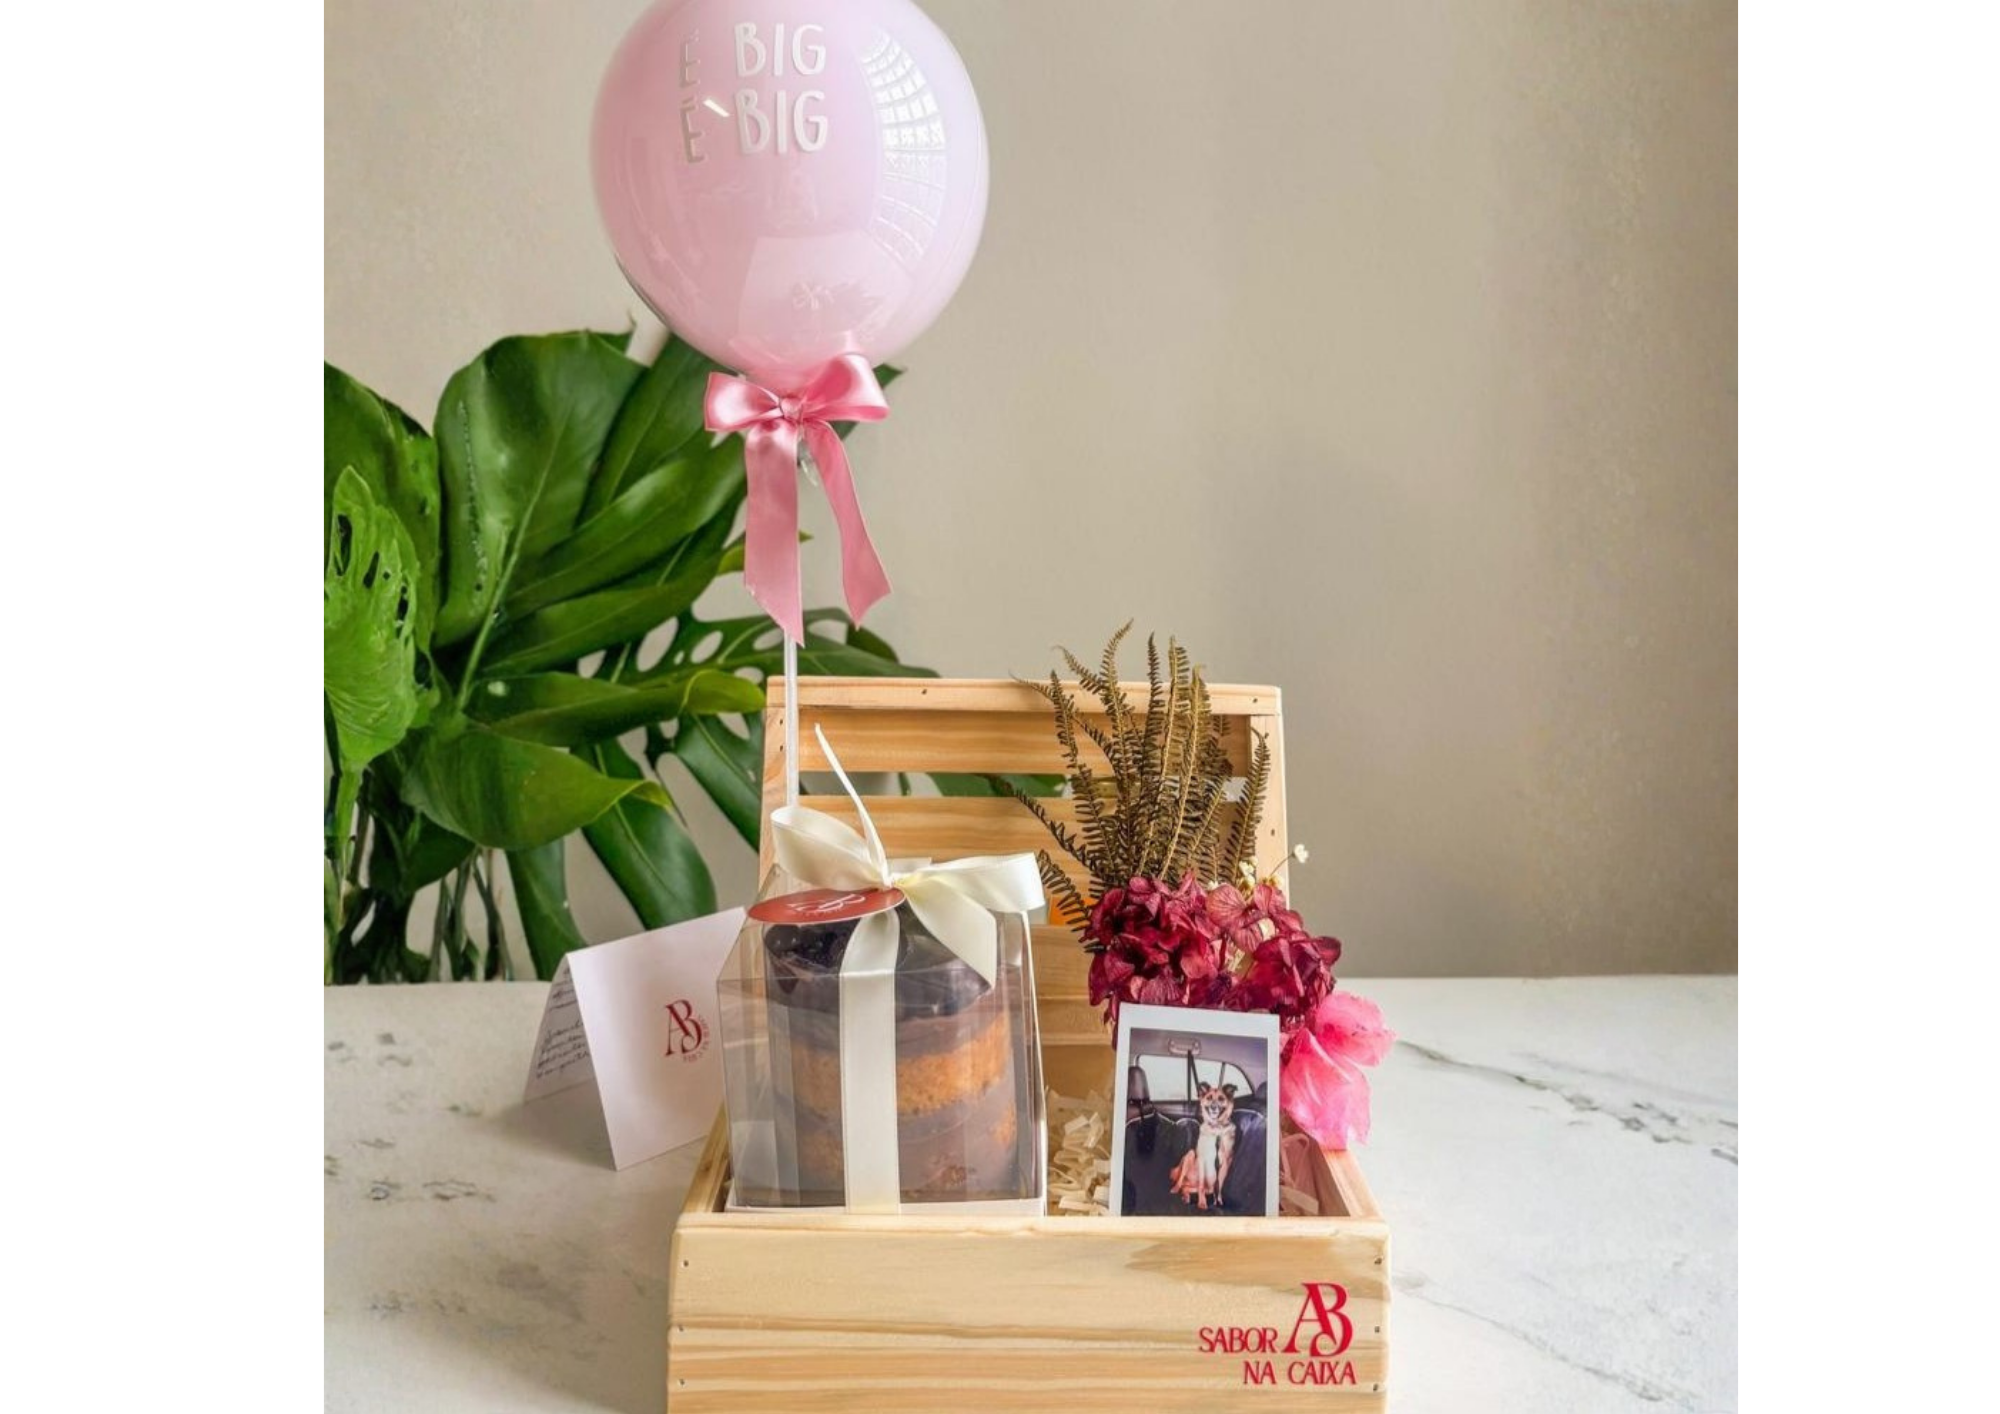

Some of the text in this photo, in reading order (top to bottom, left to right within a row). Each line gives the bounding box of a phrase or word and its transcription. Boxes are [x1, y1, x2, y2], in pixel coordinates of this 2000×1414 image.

[733, 22, 827, 78] BIG
[734, 88, 829, 155] BIG
[1199, 1327, 1278, 1353] SABOR
[1281, 1283, 1353, 1357] AB
[1243, 1361, 1357, 1385] NA CAIXA
